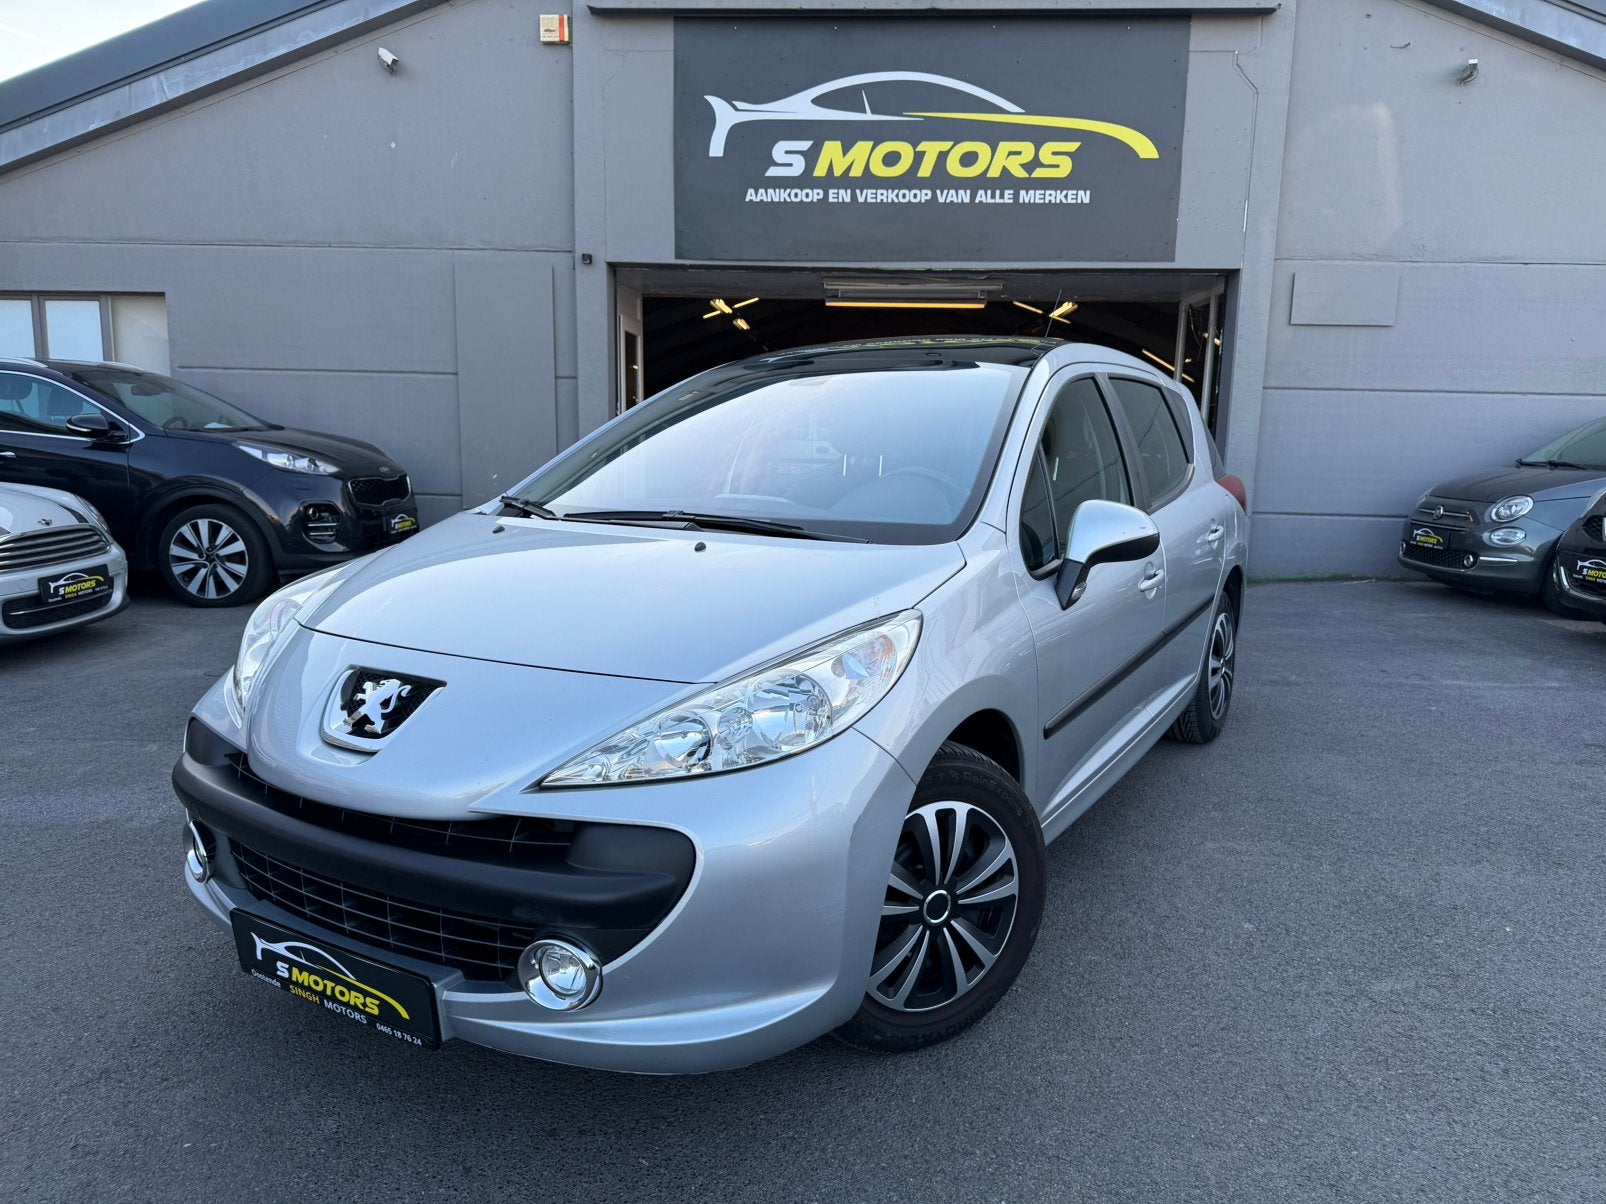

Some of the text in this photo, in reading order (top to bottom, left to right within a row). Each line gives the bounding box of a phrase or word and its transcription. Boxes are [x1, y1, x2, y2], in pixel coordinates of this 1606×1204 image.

[764, 141, 1082, 178] S MOTORS
[745, 188, 1091, 204] AANKOOP EN VERKOOP VAN ALLE MERKEN
[65, 580, 96, 594] MOTORS
[276, 961, 381, 1016] S MOTORS
[289, 984, 368, 1024] SINGH MOTORS
